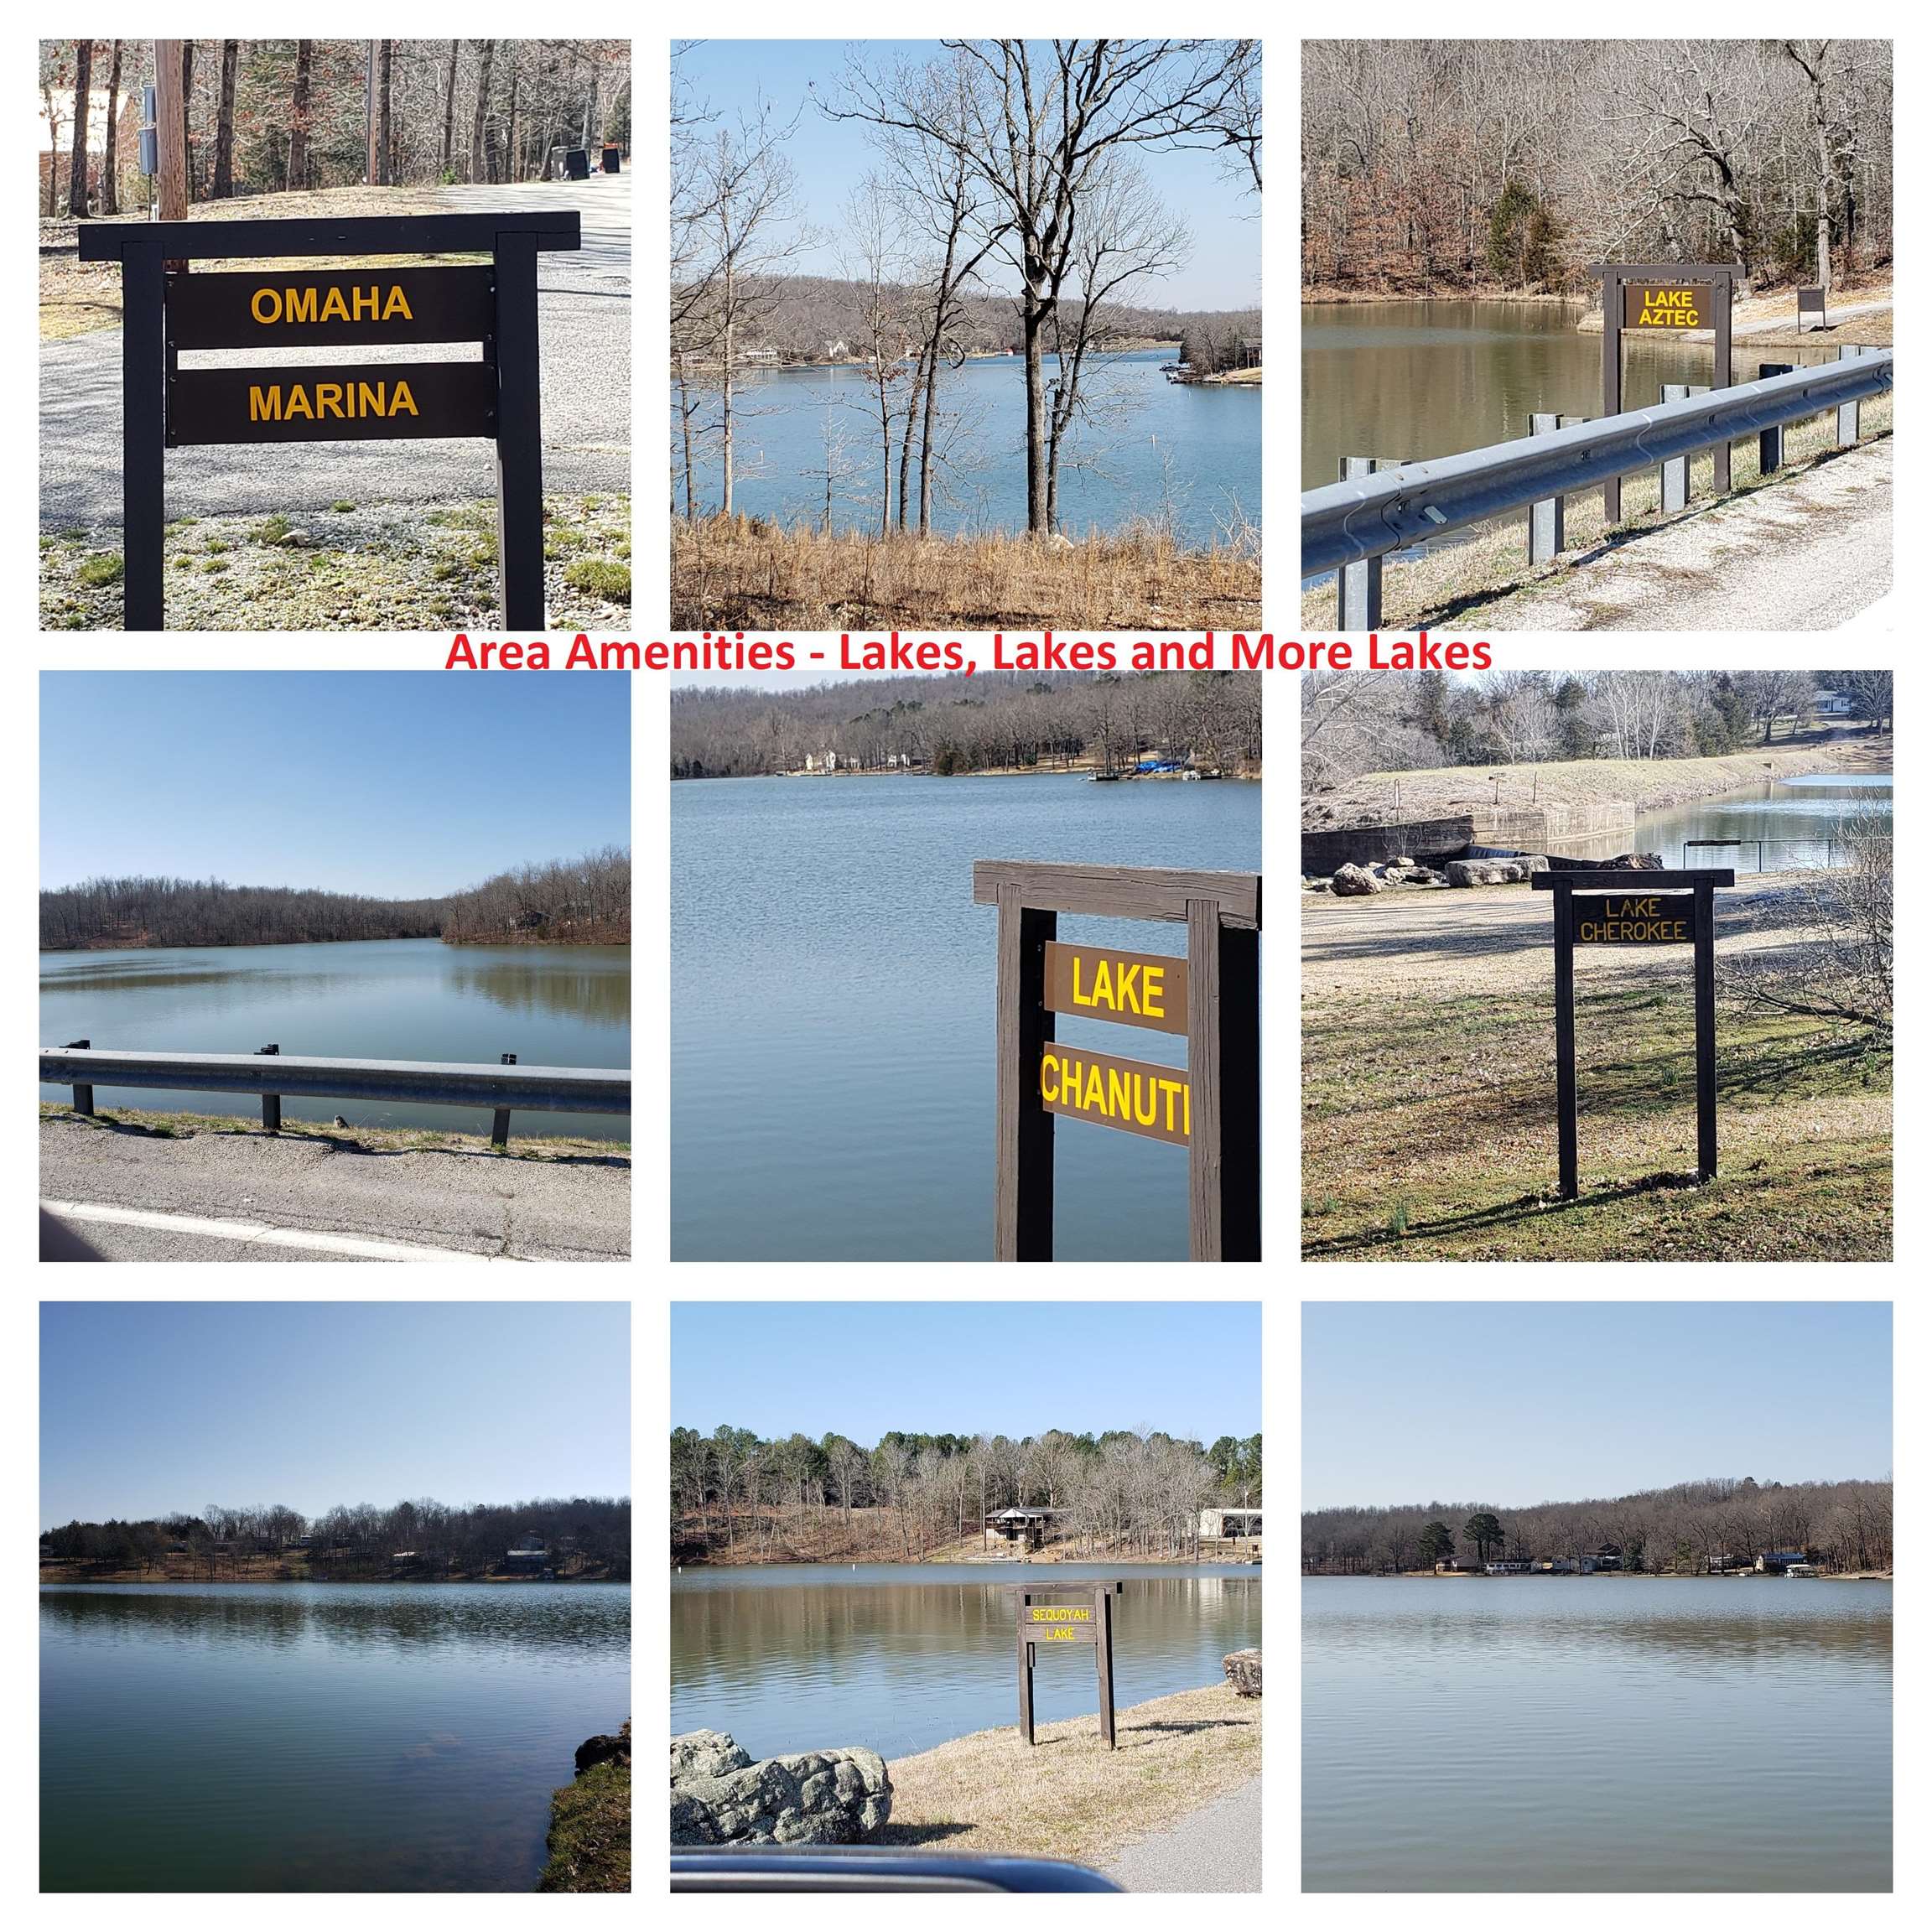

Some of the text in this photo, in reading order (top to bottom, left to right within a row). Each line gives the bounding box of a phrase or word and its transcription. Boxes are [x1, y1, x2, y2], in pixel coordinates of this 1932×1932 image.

[251, 286, 413, 324] OMAHA
[1644, 289, 1694, 308] LAKE
[1639, 308, 1700, 327] AZTEC
[249, 381, 419, 421] MARINA
[1605, 897, 1662, 918] LAKE
[1580, 921, 1687, 942] CHEROKEE
[1072, 956, 1165, 1018] LAKE
[1041, 1053, 1190, 1135] CHANUT
[1032, 1608, 1089, 1621] SEQUOYAH
[1046, 1627, 1075, 1640] LAKE
